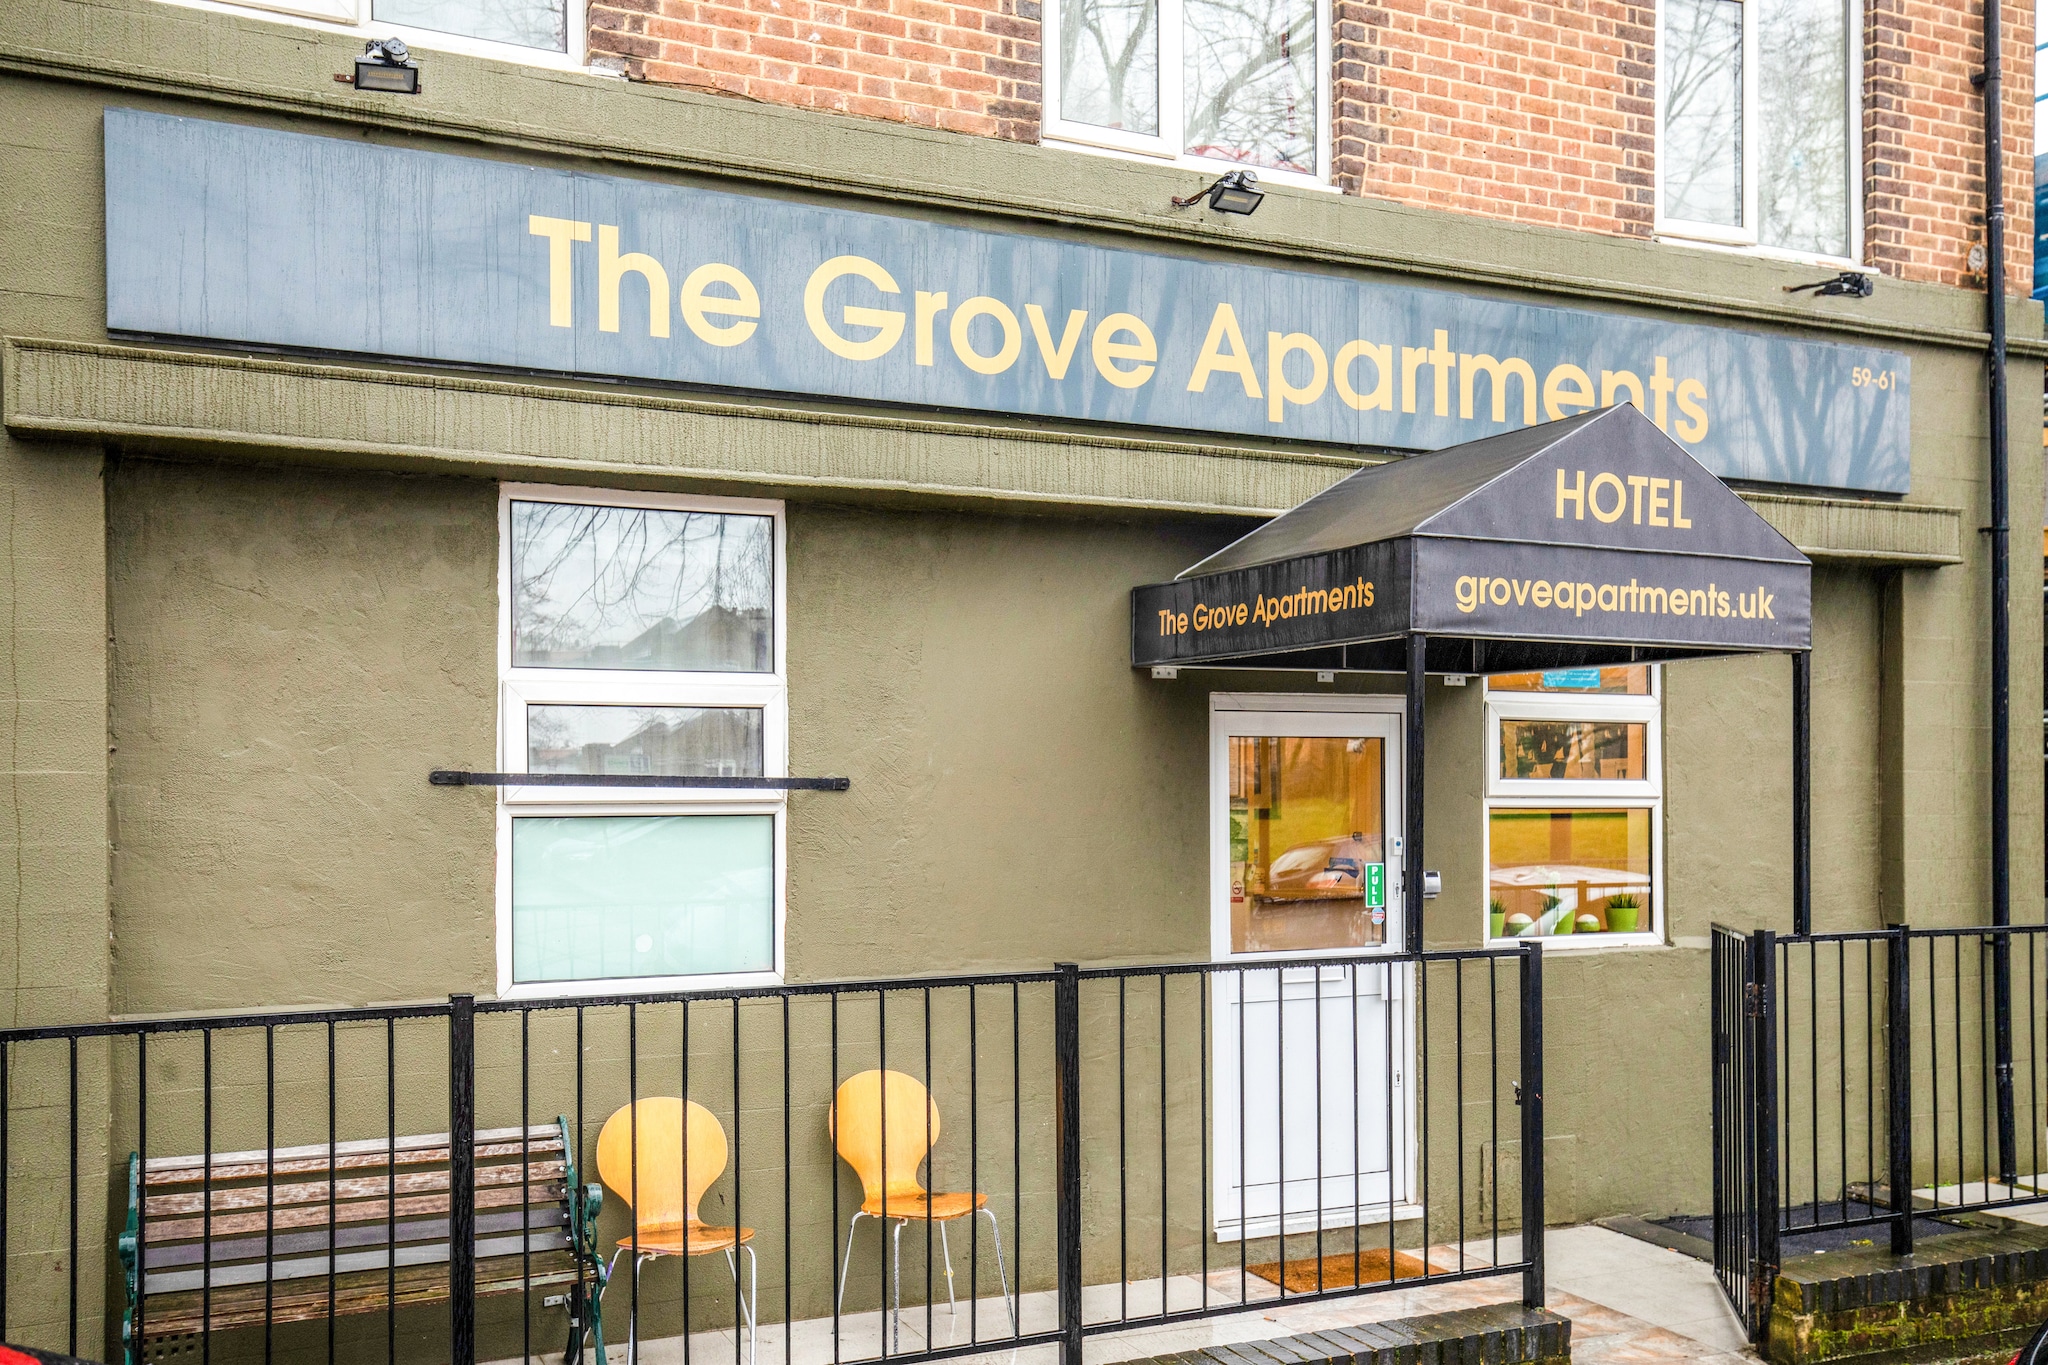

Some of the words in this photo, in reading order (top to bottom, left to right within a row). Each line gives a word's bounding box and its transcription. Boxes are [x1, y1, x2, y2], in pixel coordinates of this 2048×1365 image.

[528, 215, 761, 347] The
[804, 255, 1158, 390] Grove
[1187, 302, 1710, 444] Apartments
[1851, 366, 1896, 391] 59-61
[1555, 468, 1692, 529] HOTEL
[1158, 608, 1189, 637] The
[1192, 602, 1249, 632] Grove
[1251, 576, 1375, 628] Apartments
[1455, 574, 1776, 620] groveapartments.uk
[1371, 866, 1379, 905] PULL
